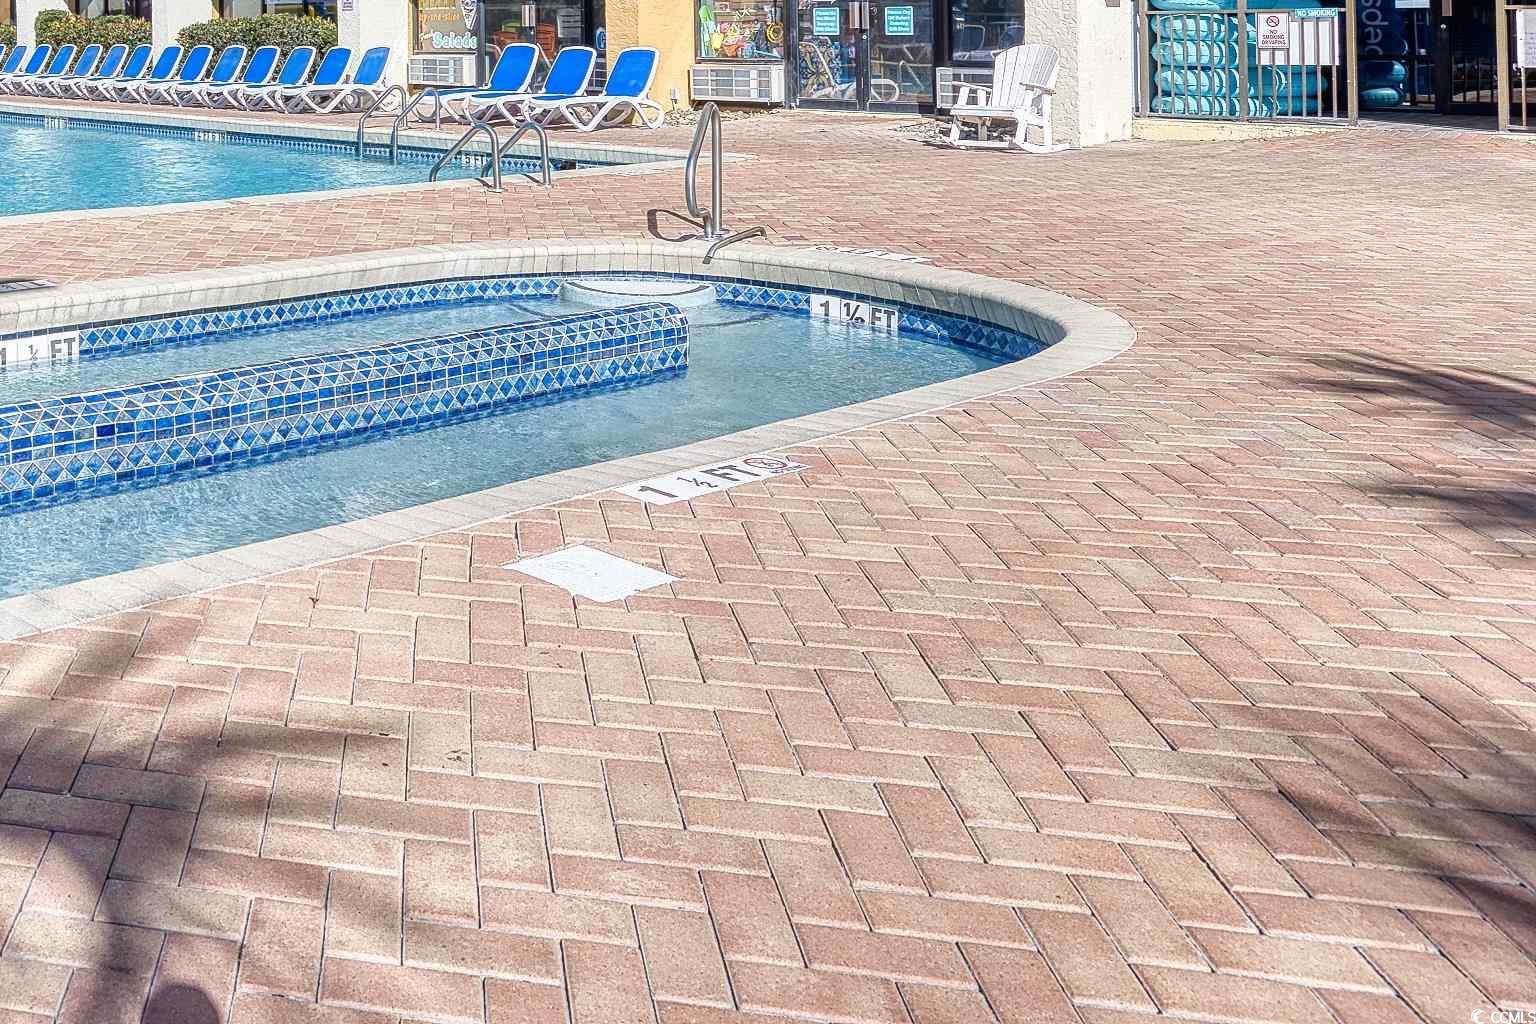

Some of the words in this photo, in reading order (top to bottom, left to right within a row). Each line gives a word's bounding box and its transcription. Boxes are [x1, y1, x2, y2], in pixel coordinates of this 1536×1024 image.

[1297, 9, 1307, 17] NO
[432, 32, 478, 50] Salads
[820, 300, 830, 317] 1
[871, 307, 896, 329] FT
[50, 337, 76, 359] FT
[638, 485, 679, 498] 1
[699, 464, 762, 482] FT
